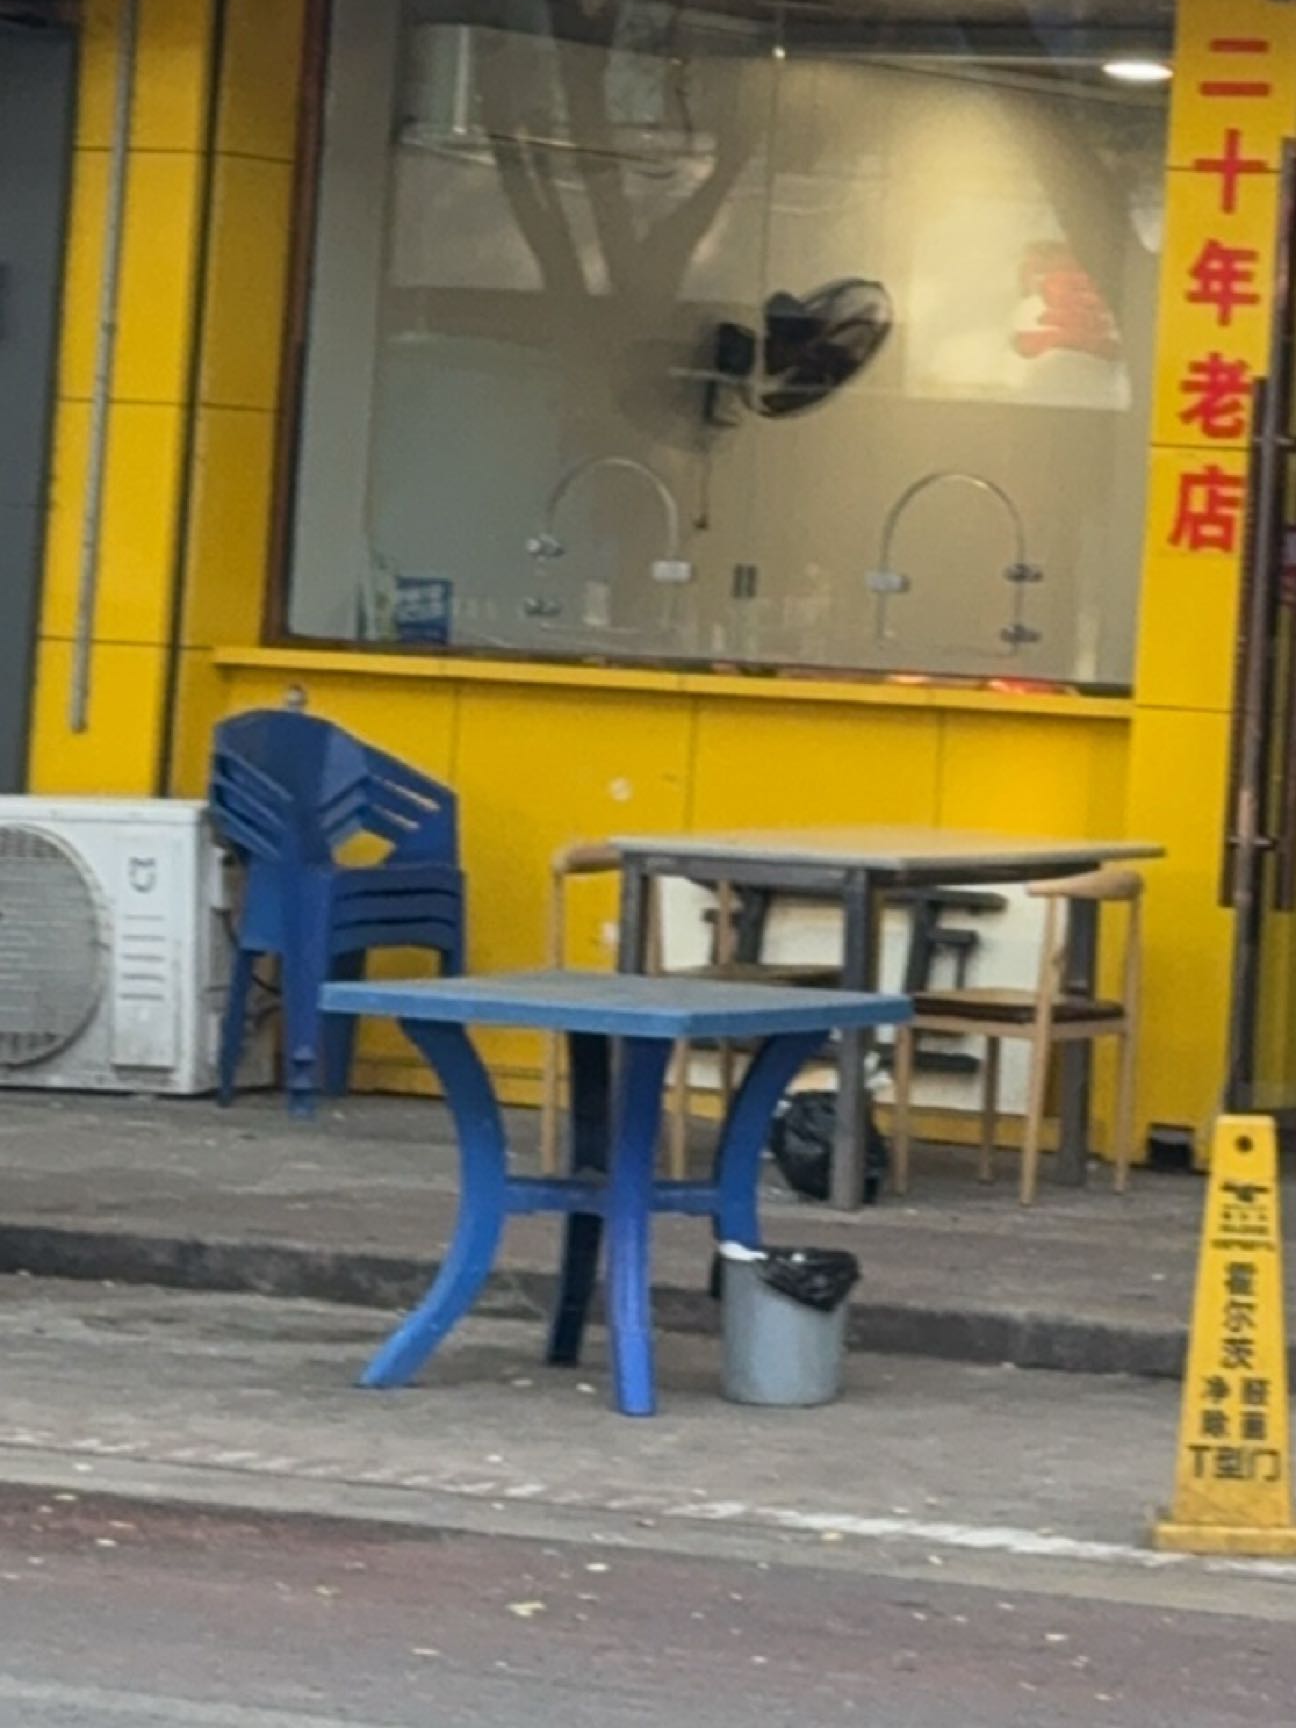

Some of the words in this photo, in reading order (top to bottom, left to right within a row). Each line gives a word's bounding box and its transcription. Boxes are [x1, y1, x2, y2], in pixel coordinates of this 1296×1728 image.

[1167, 38, 1272, 554] 二十年老店
